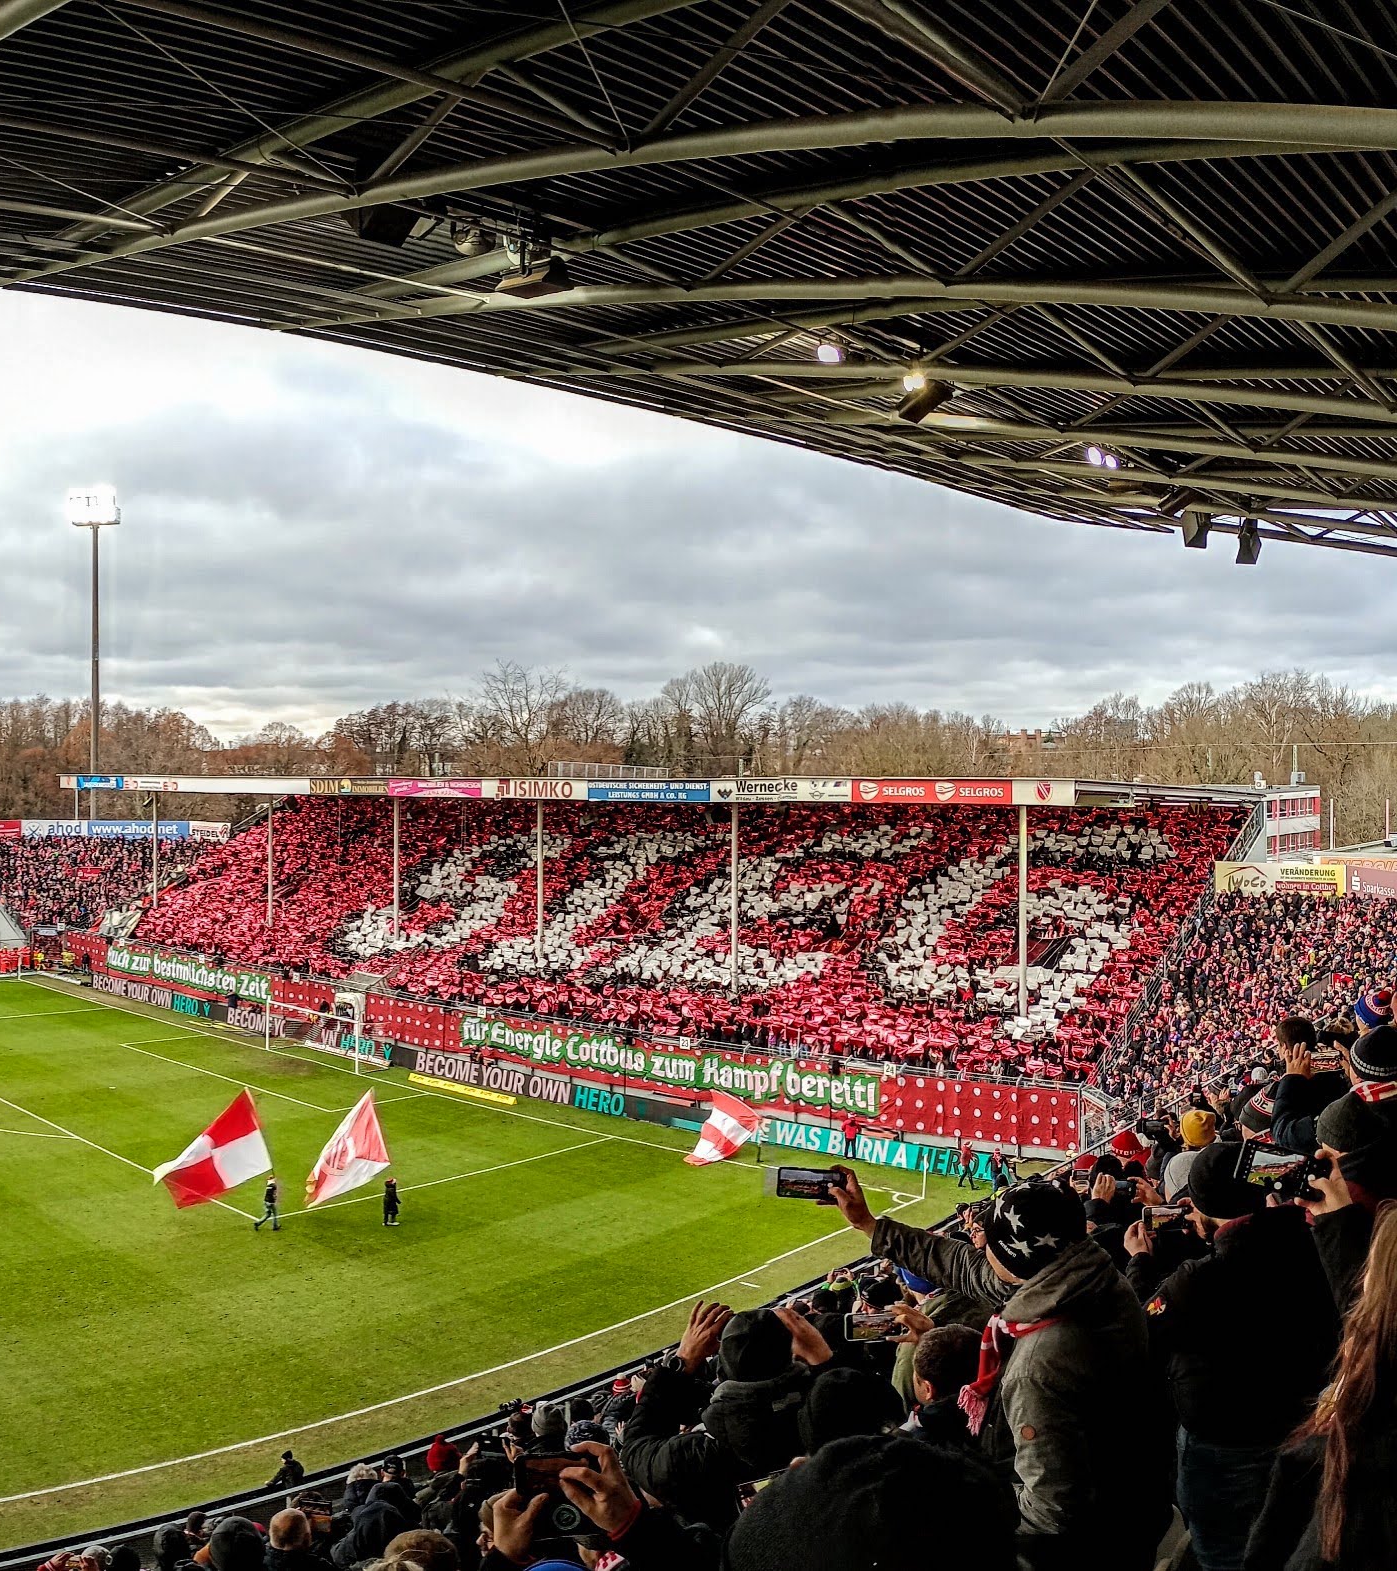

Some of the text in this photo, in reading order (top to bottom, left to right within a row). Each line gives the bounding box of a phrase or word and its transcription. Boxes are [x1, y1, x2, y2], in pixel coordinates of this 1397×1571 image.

[310, 780, 339, 793] SDIM
[513, 780, 573, 798] ISIMKO
[735, 779, 798, 792] Wernecke
[882, 786, 925, 796] SELGROS
[959, 786, 1004, 797] SELGROS
[48, 821, 81, 835] ahod
[92, 823, 178, 834] www.ahodnet
[1280, 867, 1336, 877] VERÄNDERUNG
[1310, 882, 1337, 891] Cottbus
[1362, 881, 1396, 897] Sparkasse
[92, 974, 127, 997] BECOME
[127, 981, 150, 1002] YOUR
[150, 988, 172, 1009] OWN
[461, 1016, 875, 1111] für Energie Cottbus zum Kampf bereit!
[415, 1051, 479, 1085] BECOME
[479, 1064, 525, 1096] YOUR
[528, 1075, 572, 1105] OWN
[573, 1085, 628, 1117] HERO.
[776, 1121, 822, 1151] WAS
[827, 1132, 889, 1164] BRN
[892, 1146, 907, 1169] A
